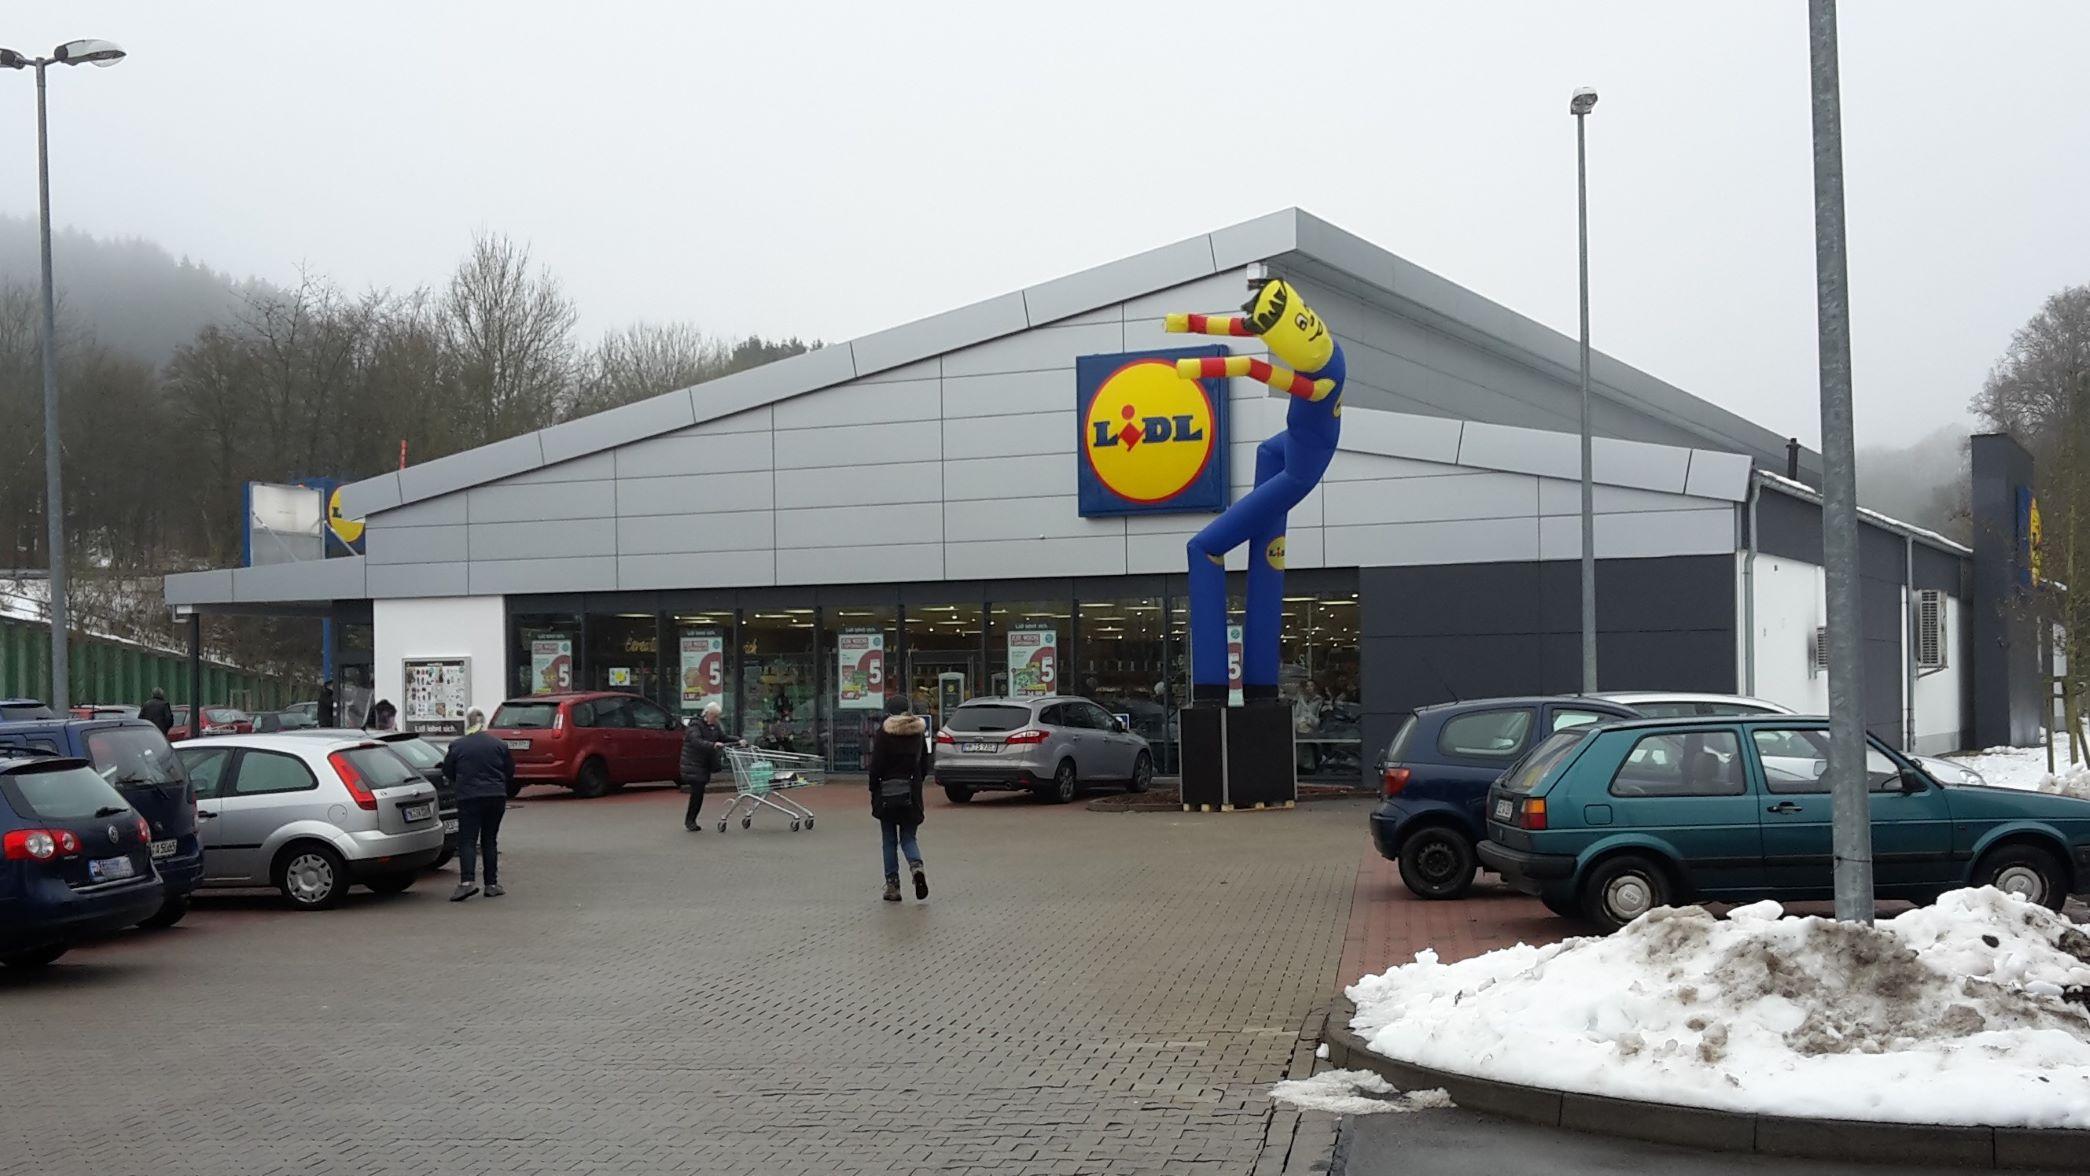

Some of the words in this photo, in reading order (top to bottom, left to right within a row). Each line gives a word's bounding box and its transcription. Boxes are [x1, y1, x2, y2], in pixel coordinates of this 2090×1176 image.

[558, 663, 569, 687] 5
[709, 661, 721, 686] 5
[869, 658, 881, 684] 5
[1041, 656, 1054, 682] 5
[1228, 652, 1242, 679] 5
